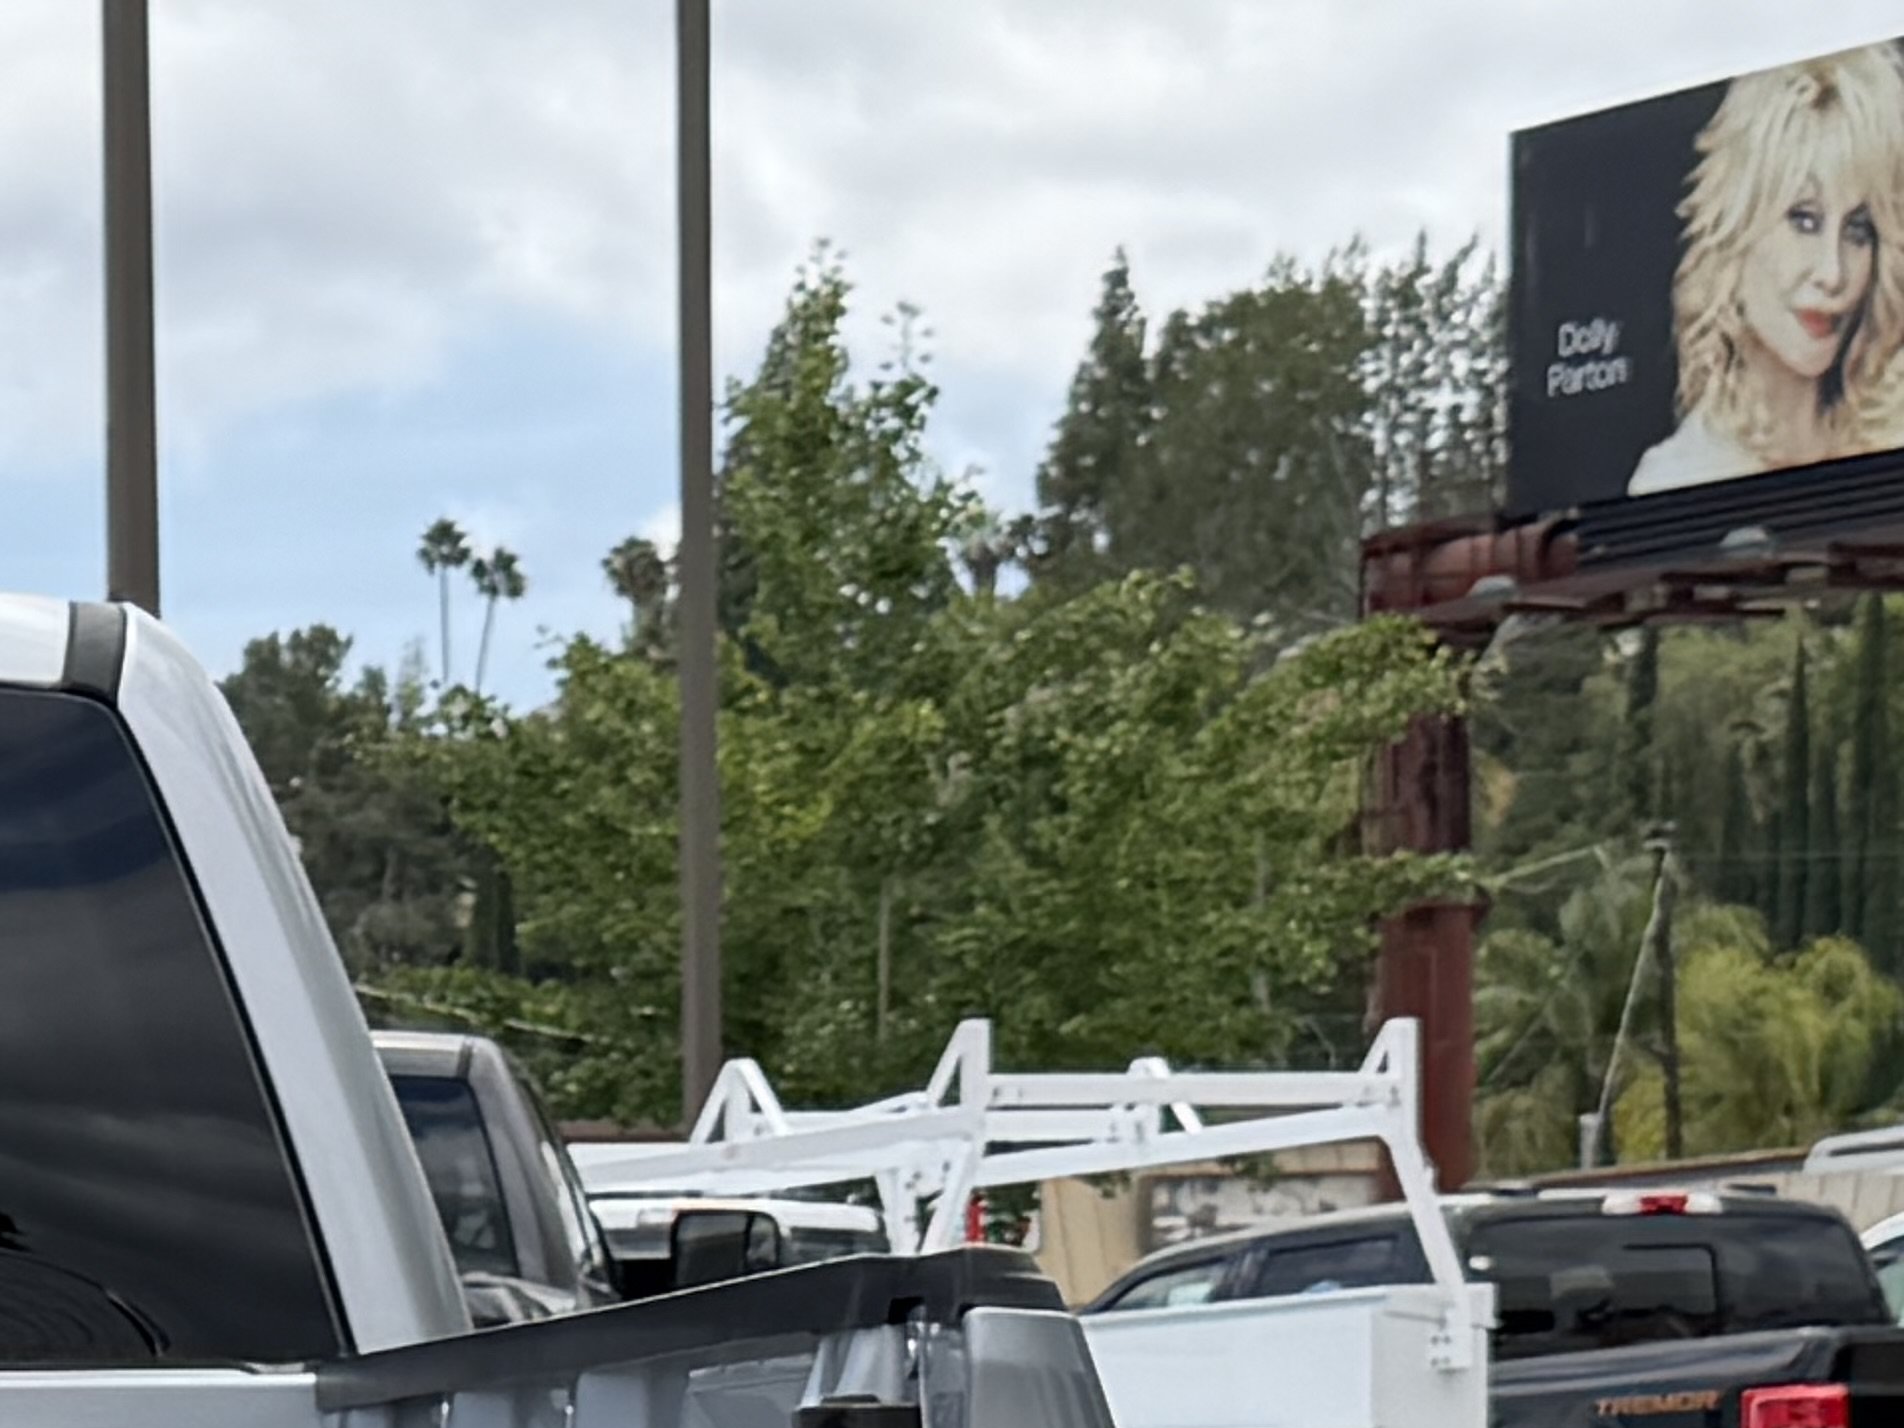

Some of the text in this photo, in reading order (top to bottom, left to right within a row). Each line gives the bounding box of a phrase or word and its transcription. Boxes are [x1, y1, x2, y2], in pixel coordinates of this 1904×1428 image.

[1557, 317, 1619, 356] Dolly
[1546, 357, 1629, 398] Parton
[1596, 1390, 1722, 1416] TREMOR
